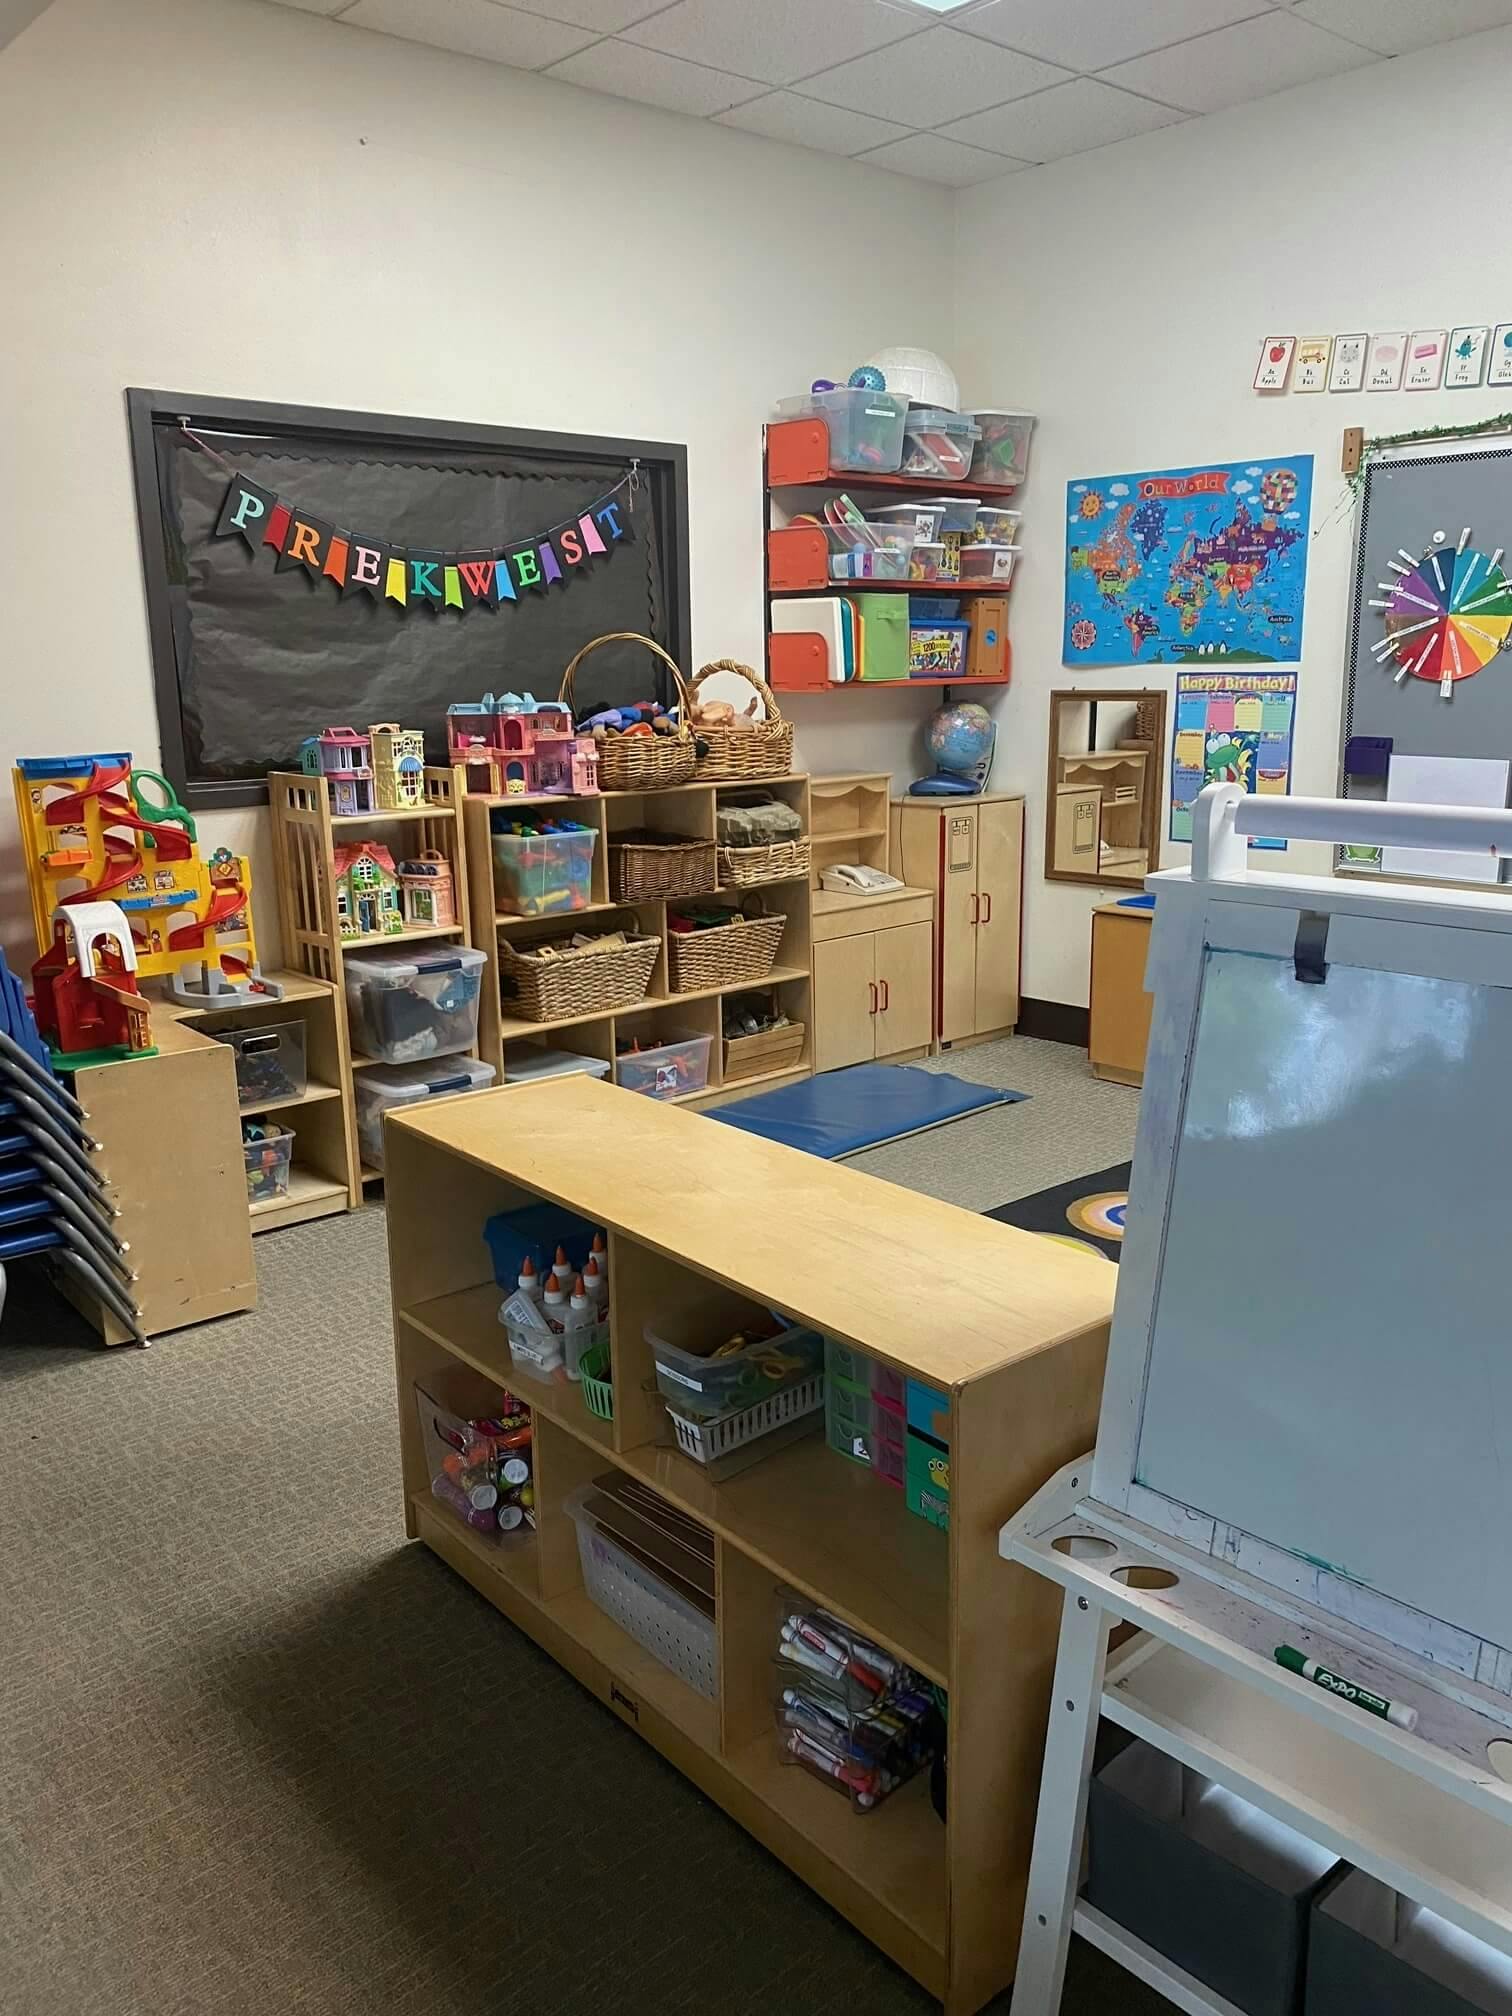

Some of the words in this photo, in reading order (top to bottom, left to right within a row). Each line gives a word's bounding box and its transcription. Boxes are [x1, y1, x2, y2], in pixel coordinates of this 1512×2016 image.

[1143, 483, 1172, 497] Our
[1175, 474, 1219, 494] World
[923, 641, 936, 653] 1200
[1181, 676, 1223, 691] Happy
[1227, 675, 1295, 690] Birthday!
[1318, 1673, 1357, 1698] EXPO
